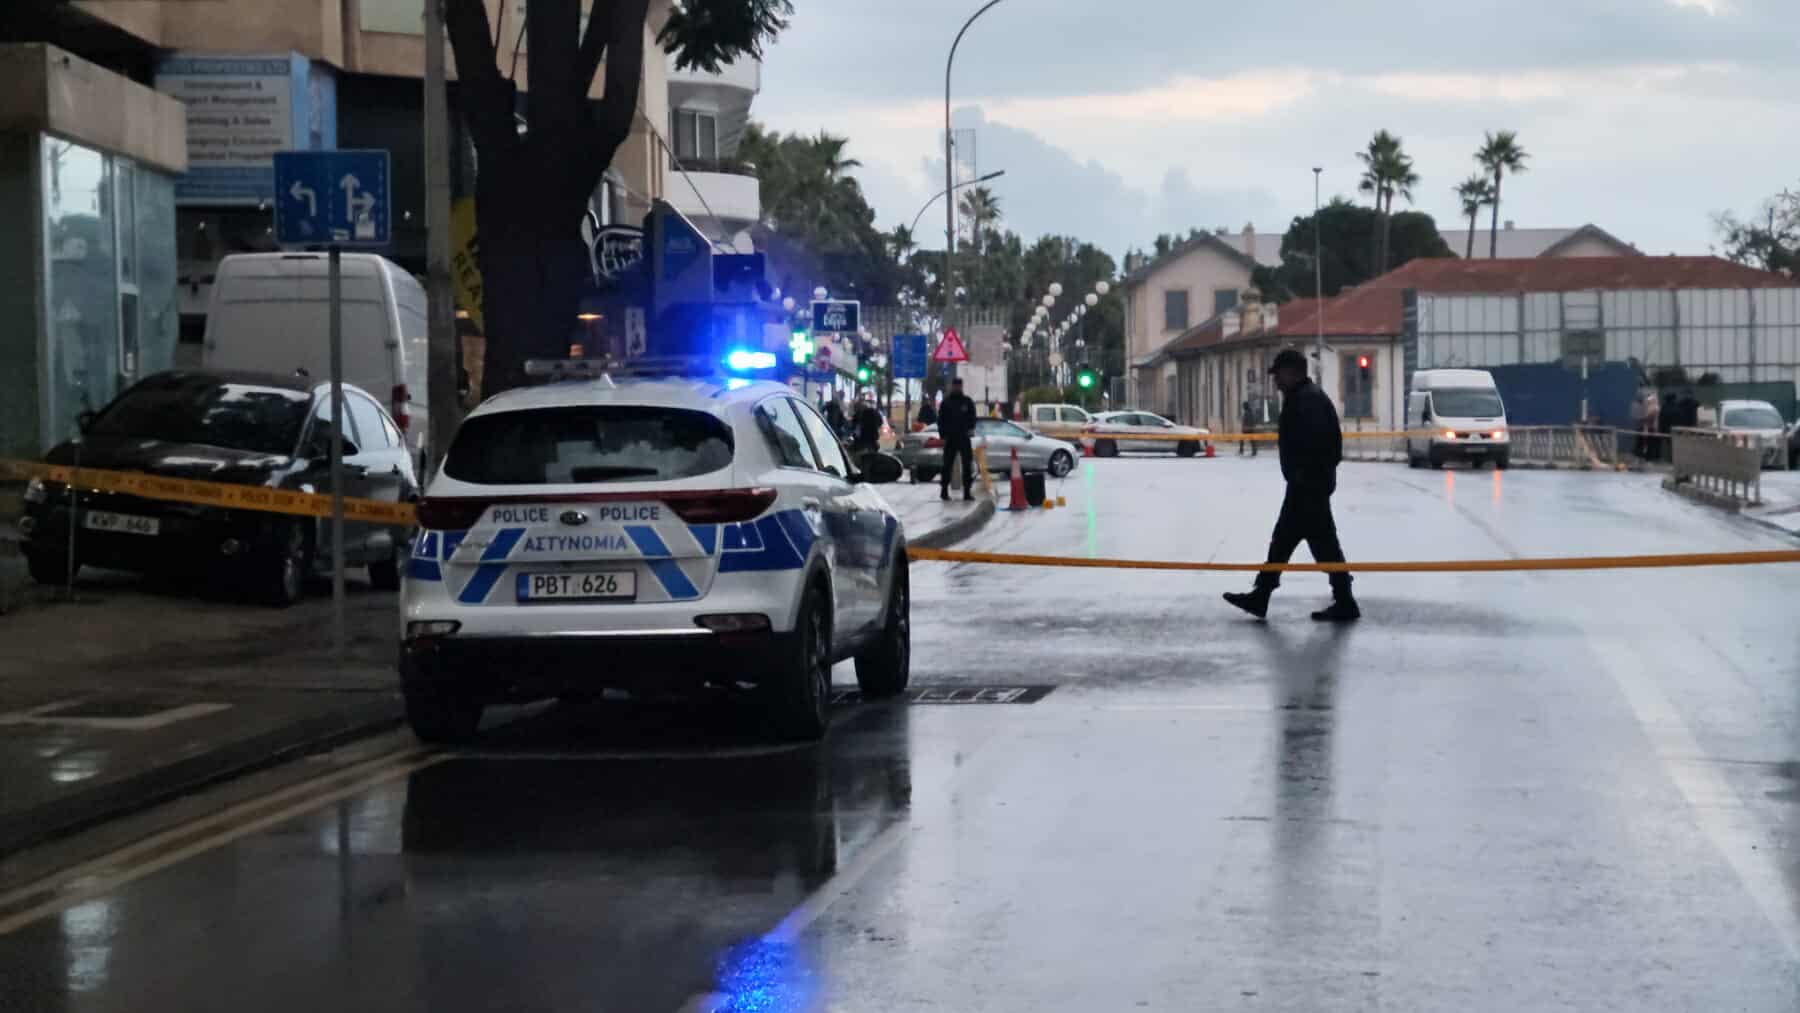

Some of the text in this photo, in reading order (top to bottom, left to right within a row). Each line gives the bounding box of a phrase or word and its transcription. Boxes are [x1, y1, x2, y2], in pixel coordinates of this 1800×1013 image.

[493, 507, 549, 524] POLICE
[600, 505, 660, 521] POLICE
[524, 535, 628, 551] ΑΣΤΥΝΟΜΙΑ
[534, 575, 617, 595] PBT 626
